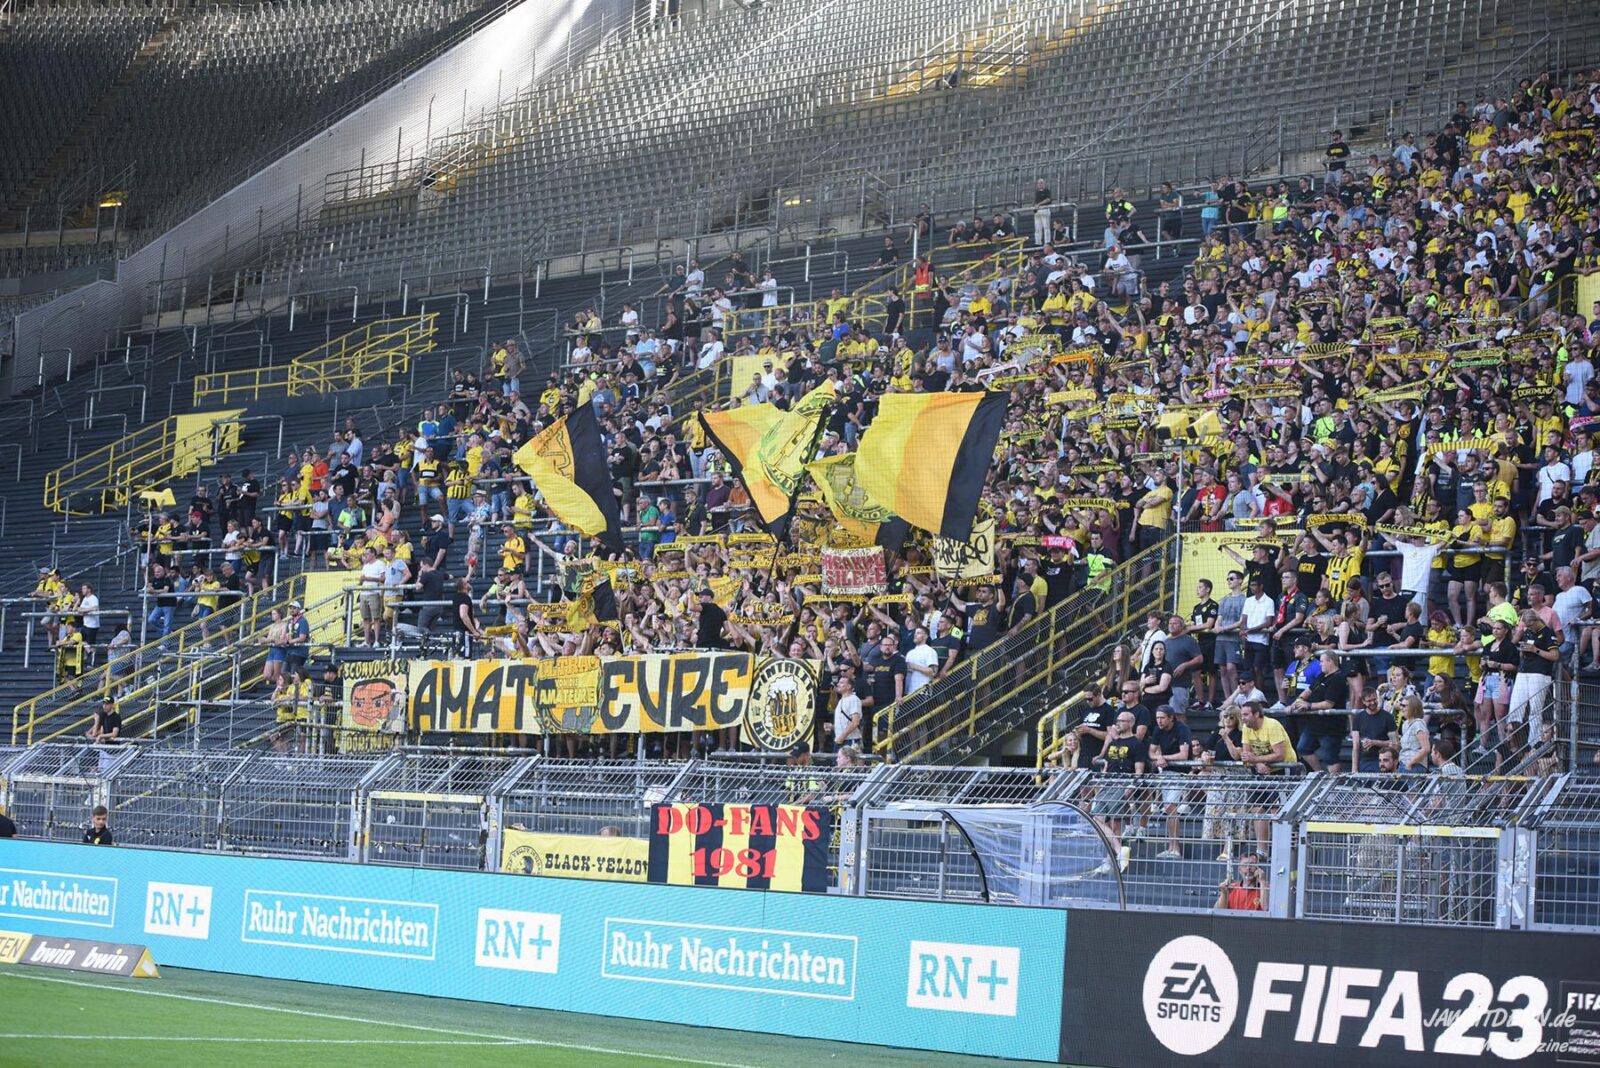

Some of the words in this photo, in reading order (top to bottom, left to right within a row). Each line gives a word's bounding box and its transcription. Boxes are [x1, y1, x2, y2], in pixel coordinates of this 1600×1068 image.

[1517, 386, 1554, 398] DORTMUND
[656, 805, 821, 841] DO-FANS
[689, 848, 777, 879] 1981
[11, 880, 110, 917] Nachrichten
[150, 890, 205, 928] RN+
[248, 901, 297, 935] Ruhr
[302, 904, 430, 948] Nachrichten
[482, 919, 553, 960] RN+
[30, 941, 76, 966] bwin
[81, 946, 129, 972] bwin
[610, 931, 673, 970] Ruhr
[679, 936, 846, 986] Nachrichten
[916, 953, 1009, 1001] RN+
[1159, 961, 1221, 1003] EA
[1157, 1001, 1221, 1023] SPORTS
[1243, 961, 1425, 1052] FIFA
[1433, 972, 1549, 1060] 23
